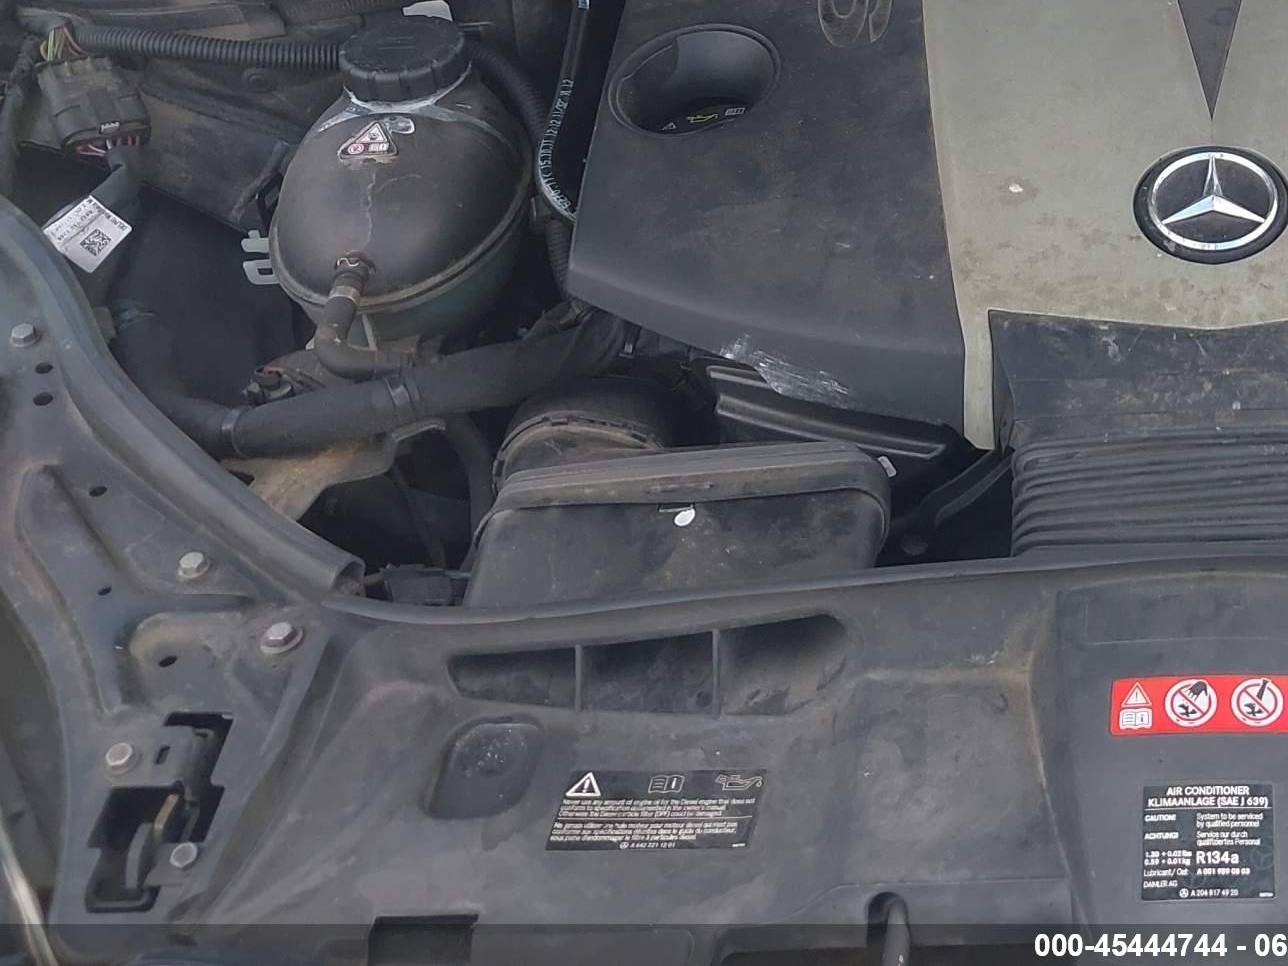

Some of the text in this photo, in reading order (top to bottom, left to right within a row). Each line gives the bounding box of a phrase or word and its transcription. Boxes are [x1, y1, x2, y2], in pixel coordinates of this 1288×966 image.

[1166, 786, 1250, 796] AIR CONDITIONER
[1147, 797, 1269, 808] KLIMAANLAGE (SAE J 639)
[1195, 850, 1240, 865] R134a
